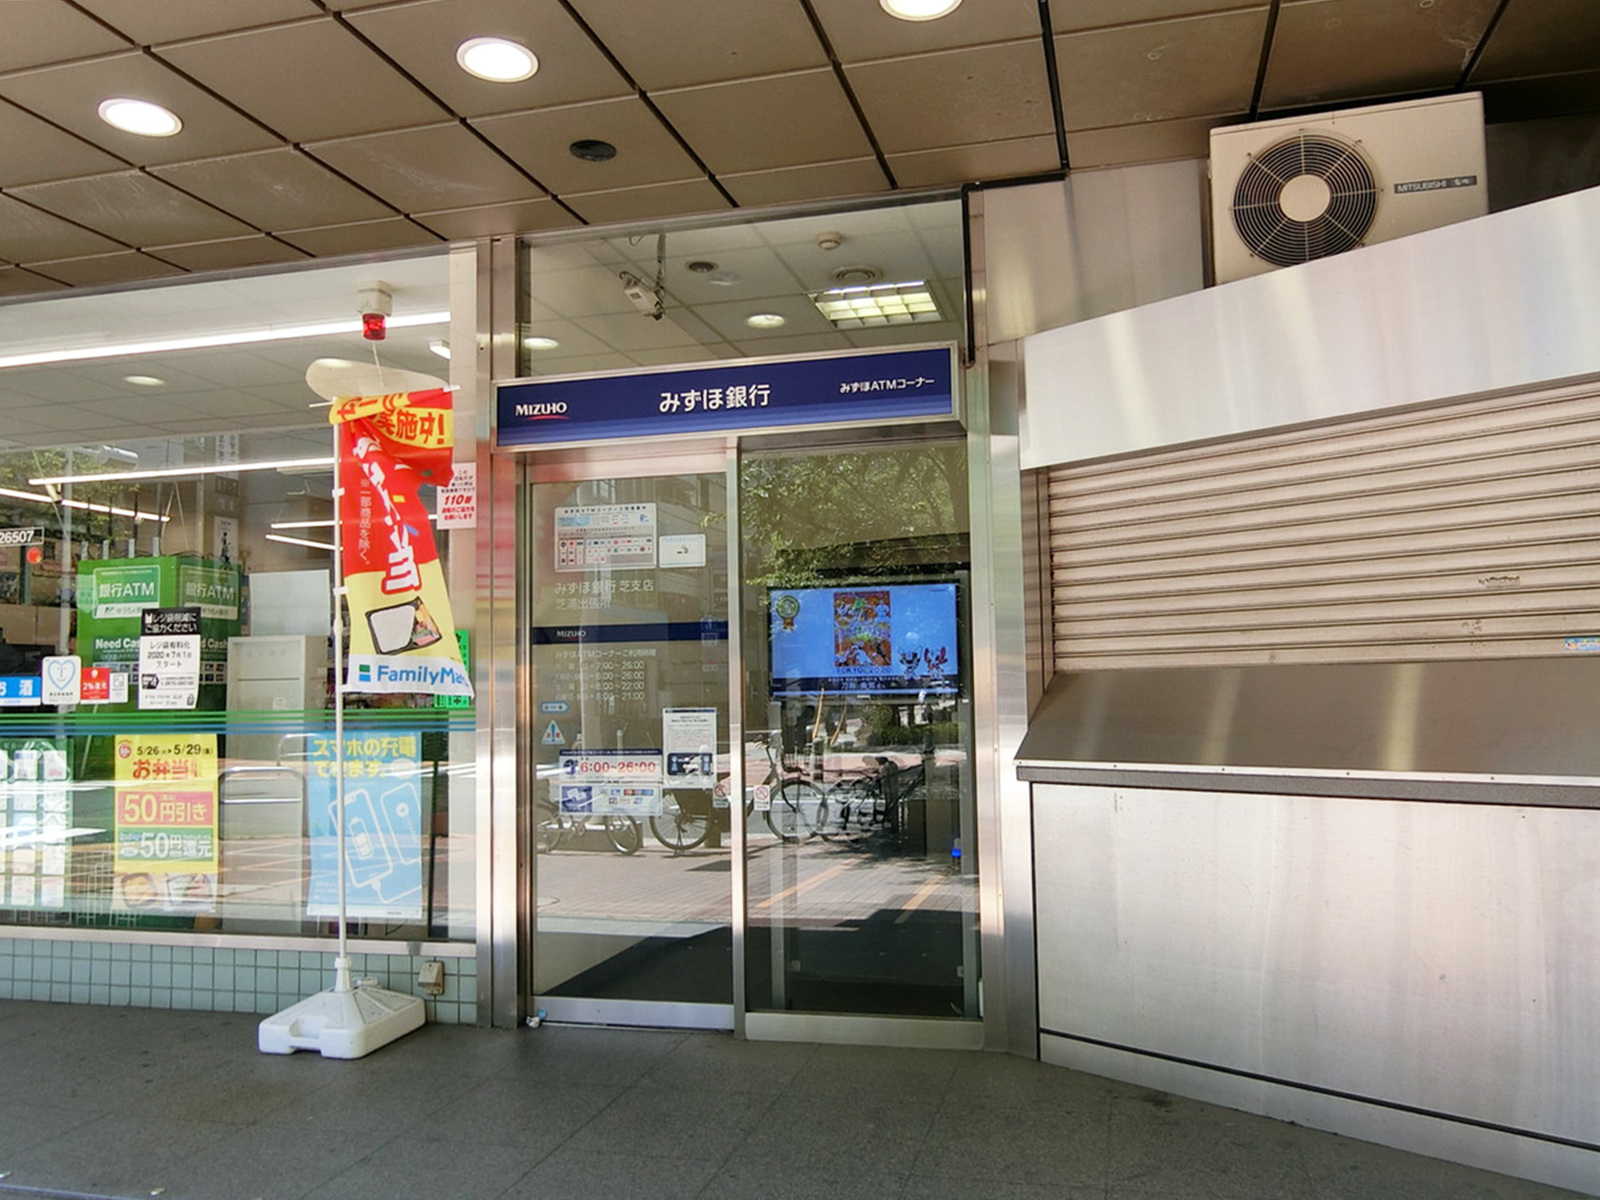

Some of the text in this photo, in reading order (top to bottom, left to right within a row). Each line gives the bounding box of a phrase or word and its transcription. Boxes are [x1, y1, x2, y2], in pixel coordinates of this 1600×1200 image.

[840, 377, 935, 393] みずほATMコーナー
[659, 384, 771, 412] みずほ銀行
[515, 402, 567, 416] MIZUHO
[99, 582, 155, 598] 銀行ATM
[186, 581, 234, 600] 銀行ATM
[554, 580, 616, 595] みずほ銀行
[95, 639, 121, 650] Need
[137, 746, 160, 755] 5/26
[174, 743, 201, 755] 5/29
[133, 759, 188, 780] お弁当
[124, 794, 206, 823] 50円引き
